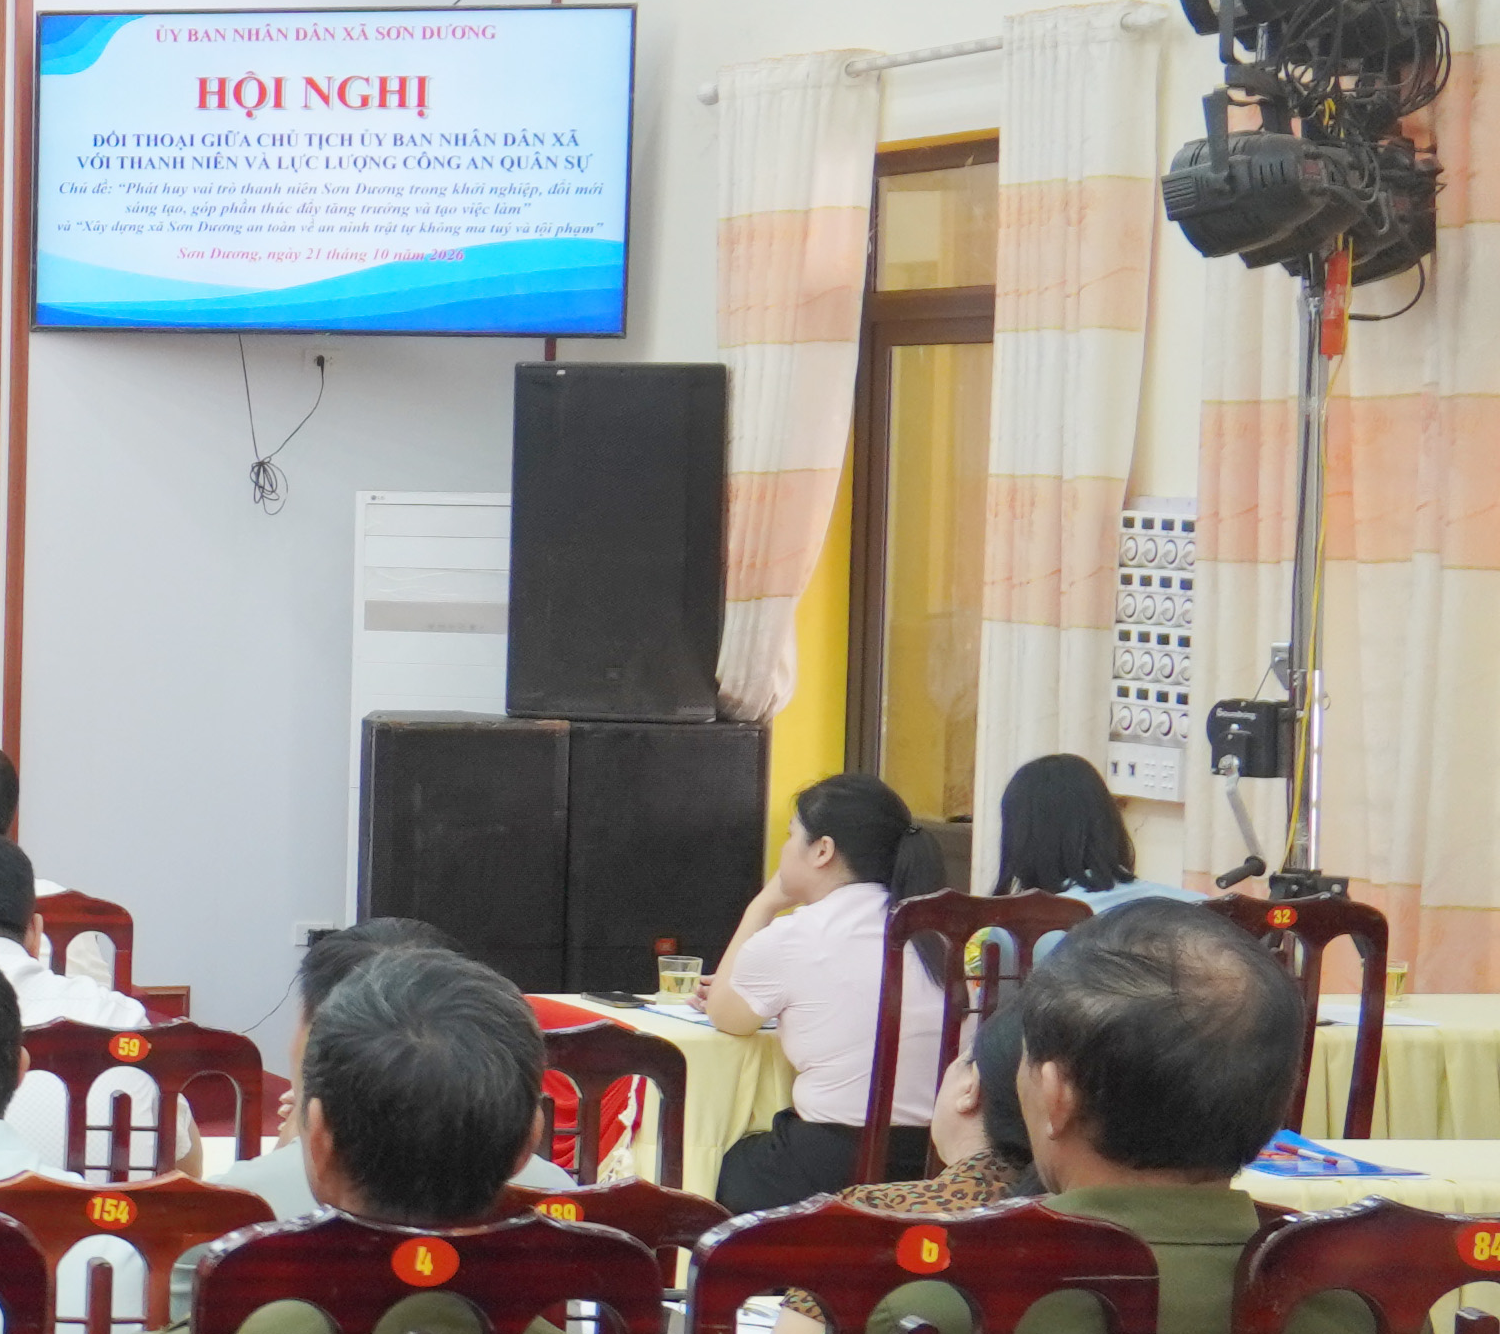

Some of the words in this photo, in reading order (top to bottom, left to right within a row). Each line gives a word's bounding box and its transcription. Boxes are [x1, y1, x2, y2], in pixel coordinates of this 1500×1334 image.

[196, 71, 287, 118] HỘI
[302, 75, 431, 118] NGHỊ
[393, 132, 433, 147] BAN
[1273, 909, 1291, 924] 32
[117, 1037, 141, 1058] 59
[91, 1195, 133, 1225] 154
[415, 1246, 434, 1276] 4
[1473, 1231, 1500, 1261] 84
